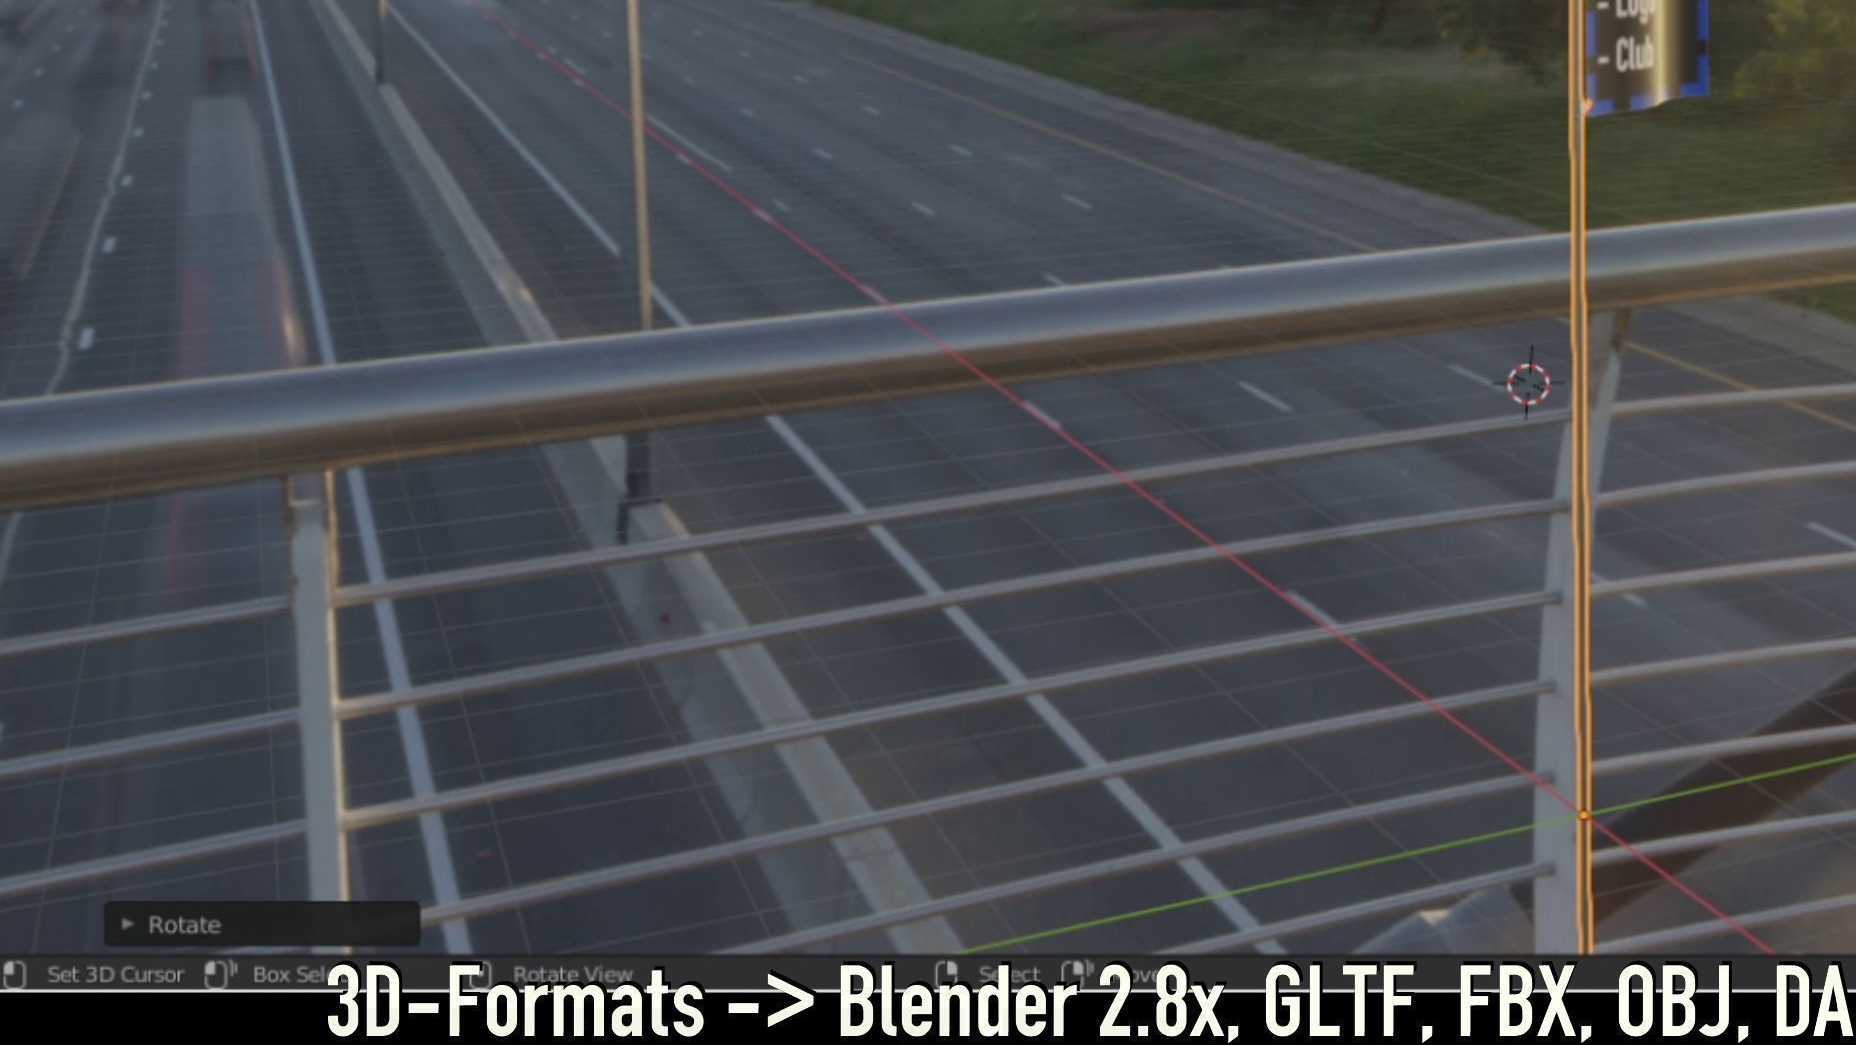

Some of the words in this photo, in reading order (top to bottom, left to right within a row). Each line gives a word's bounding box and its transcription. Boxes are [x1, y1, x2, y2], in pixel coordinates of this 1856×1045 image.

[150, 916, 221, 933] Rotate
[48, 965, 80, 983] Set
[86, 965, 114, 983] 3D
[121, 965, 185, 983] Cursor
[254, 965, 290, 983] Box
[514, 965, 579, 983] Rotate
[585, 965, 634, 983] View
